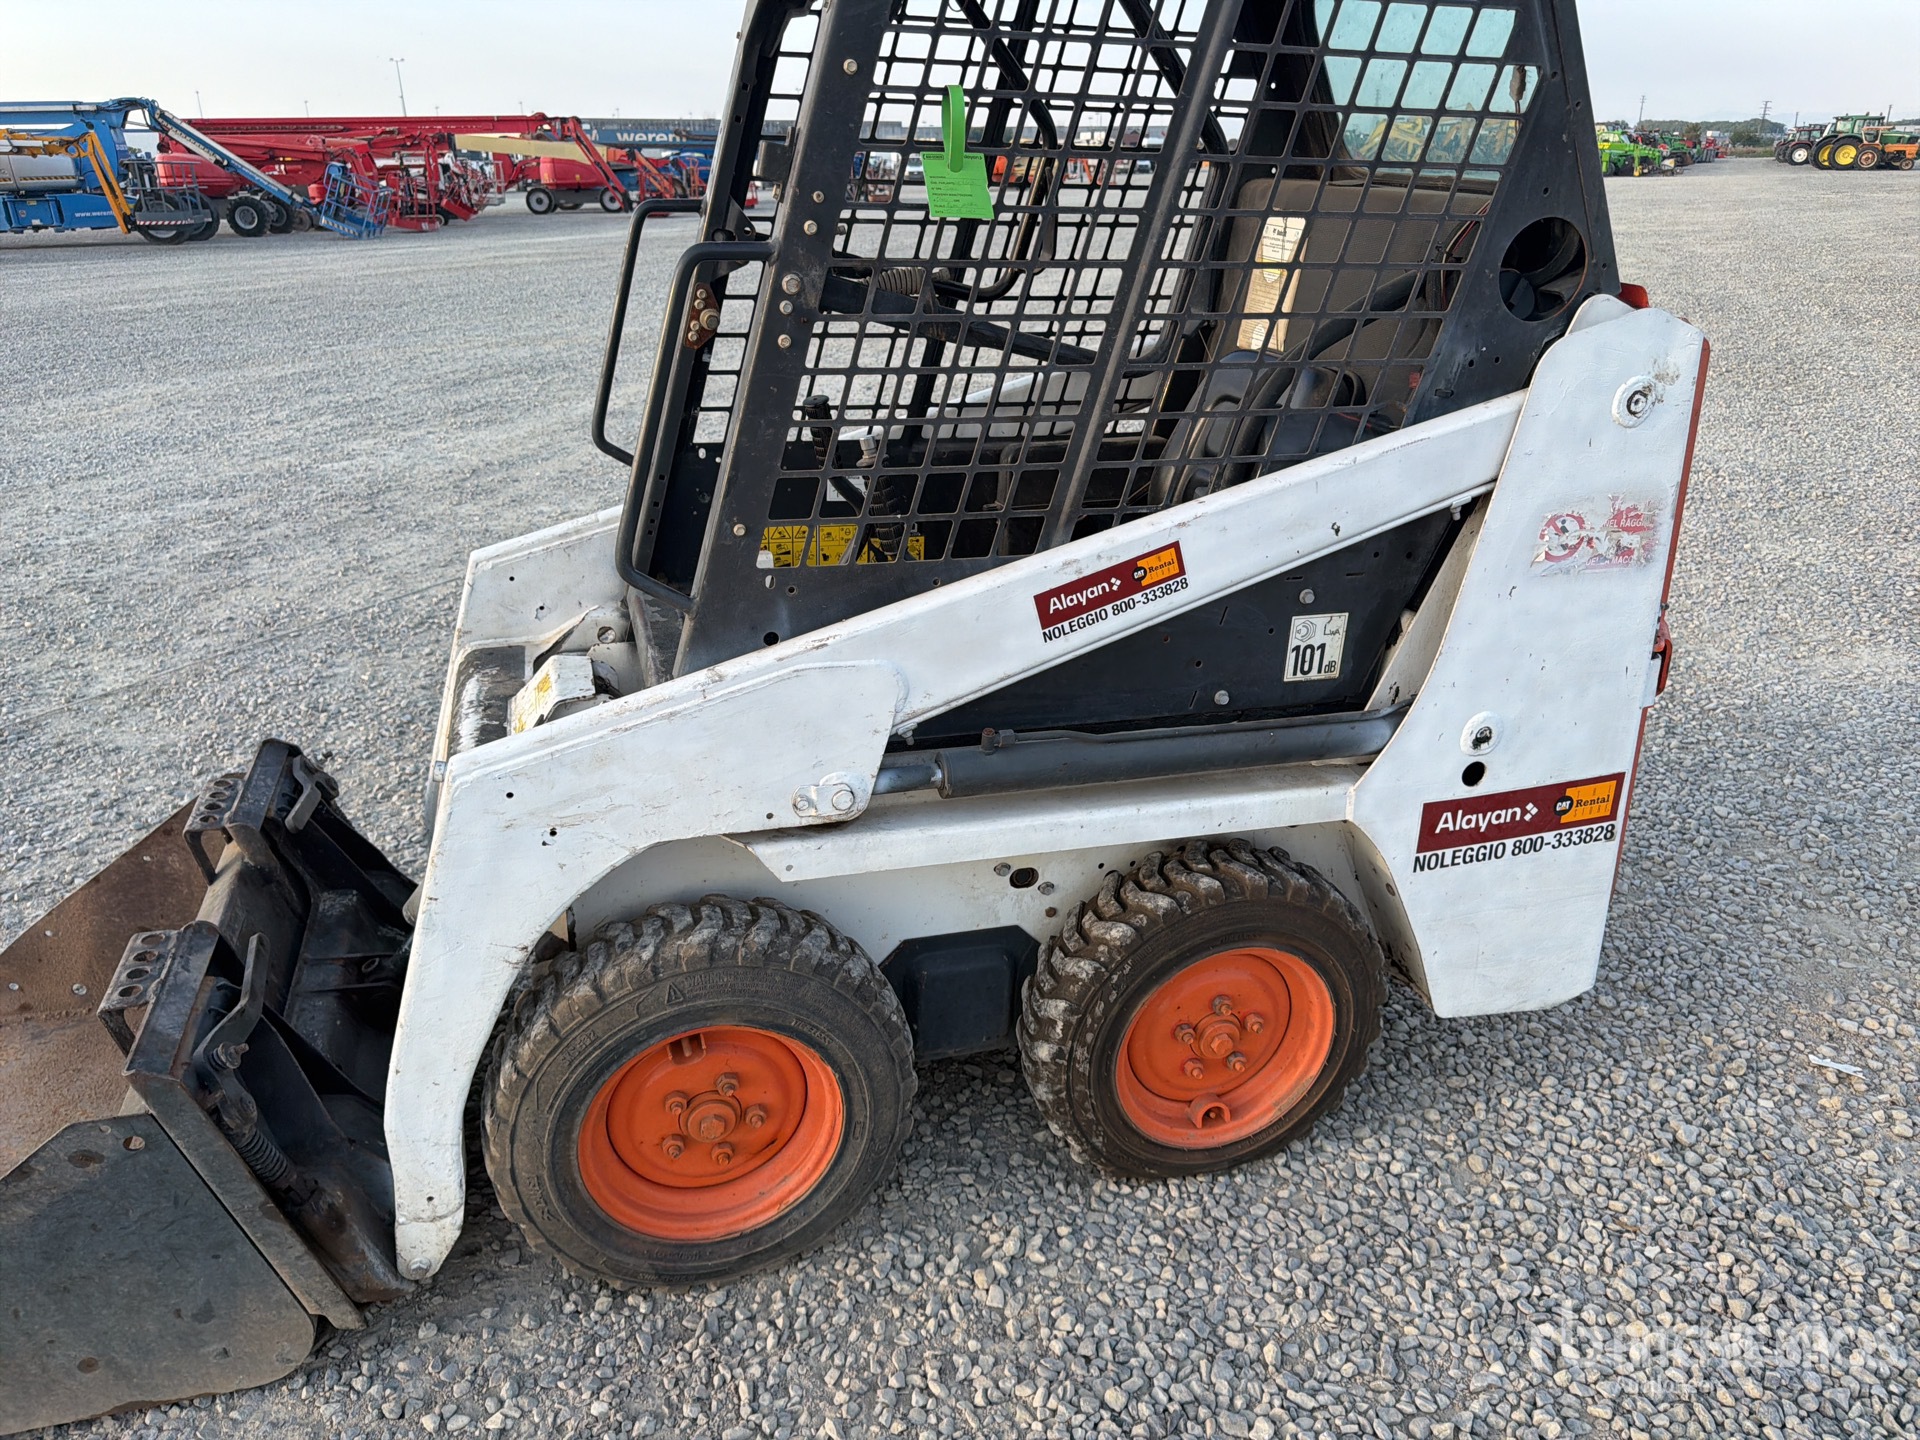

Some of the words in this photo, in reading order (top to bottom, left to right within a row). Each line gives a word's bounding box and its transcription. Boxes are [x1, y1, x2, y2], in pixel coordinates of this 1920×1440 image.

[1133, 568, 1145, 579] CAT
[1148, 558, 1175, 573] Rental
[1042, 608, 1108, 643] NOLEGGIO
[1112, 577, 1189, 616] 800-333828
[1049, 582, 1110, 615] Alayan
[1291, 642, 1326, 676] 101
[1324, 660, 1337, 673] dB
[1435, 806, 1521, 833] Alayan
[1555, 799, 1572, 811] CAT
[1575, 795, 1610, 808] Rental
[1412, 842, 1507, 873] NOLEGGIO
[1511, 823, 1616, 856] 800-333828
